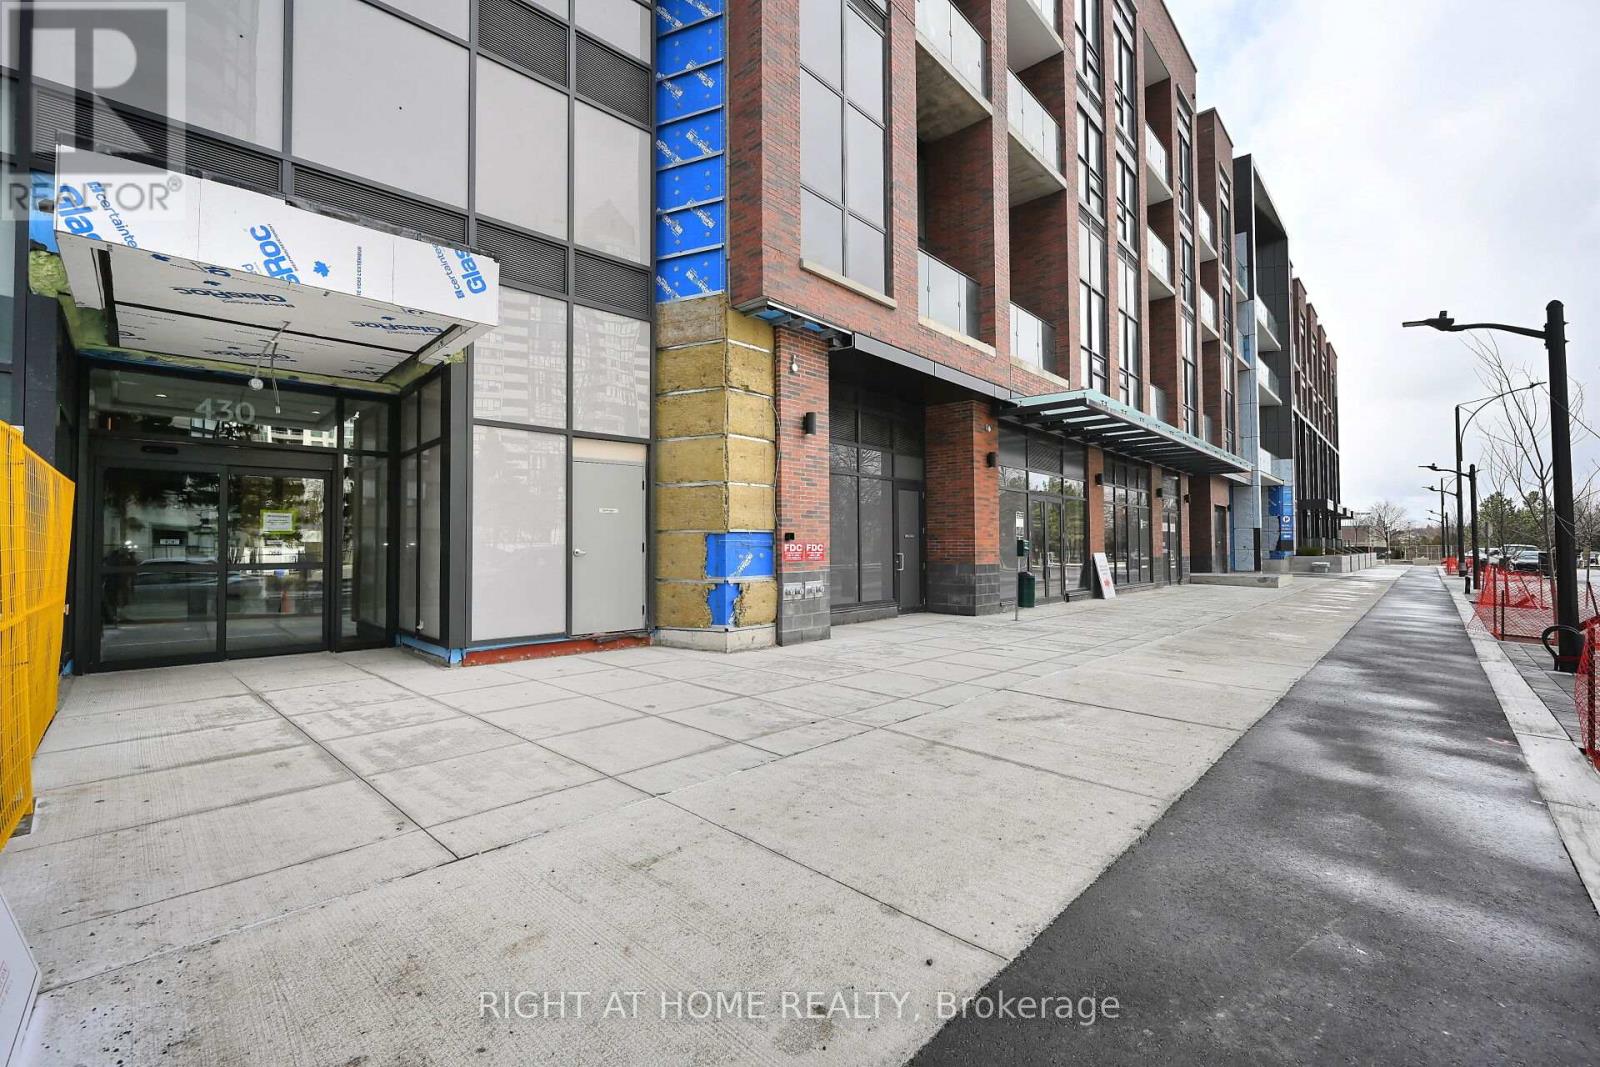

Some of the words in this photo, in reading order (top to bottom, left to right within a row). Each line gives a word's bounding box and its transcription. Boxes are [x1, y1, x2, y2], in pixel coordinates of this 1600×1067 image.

[195, 398, 256, 425] 430
[784, 543, 803, 552] FDC
[806, 543, 824, 552] FDC
